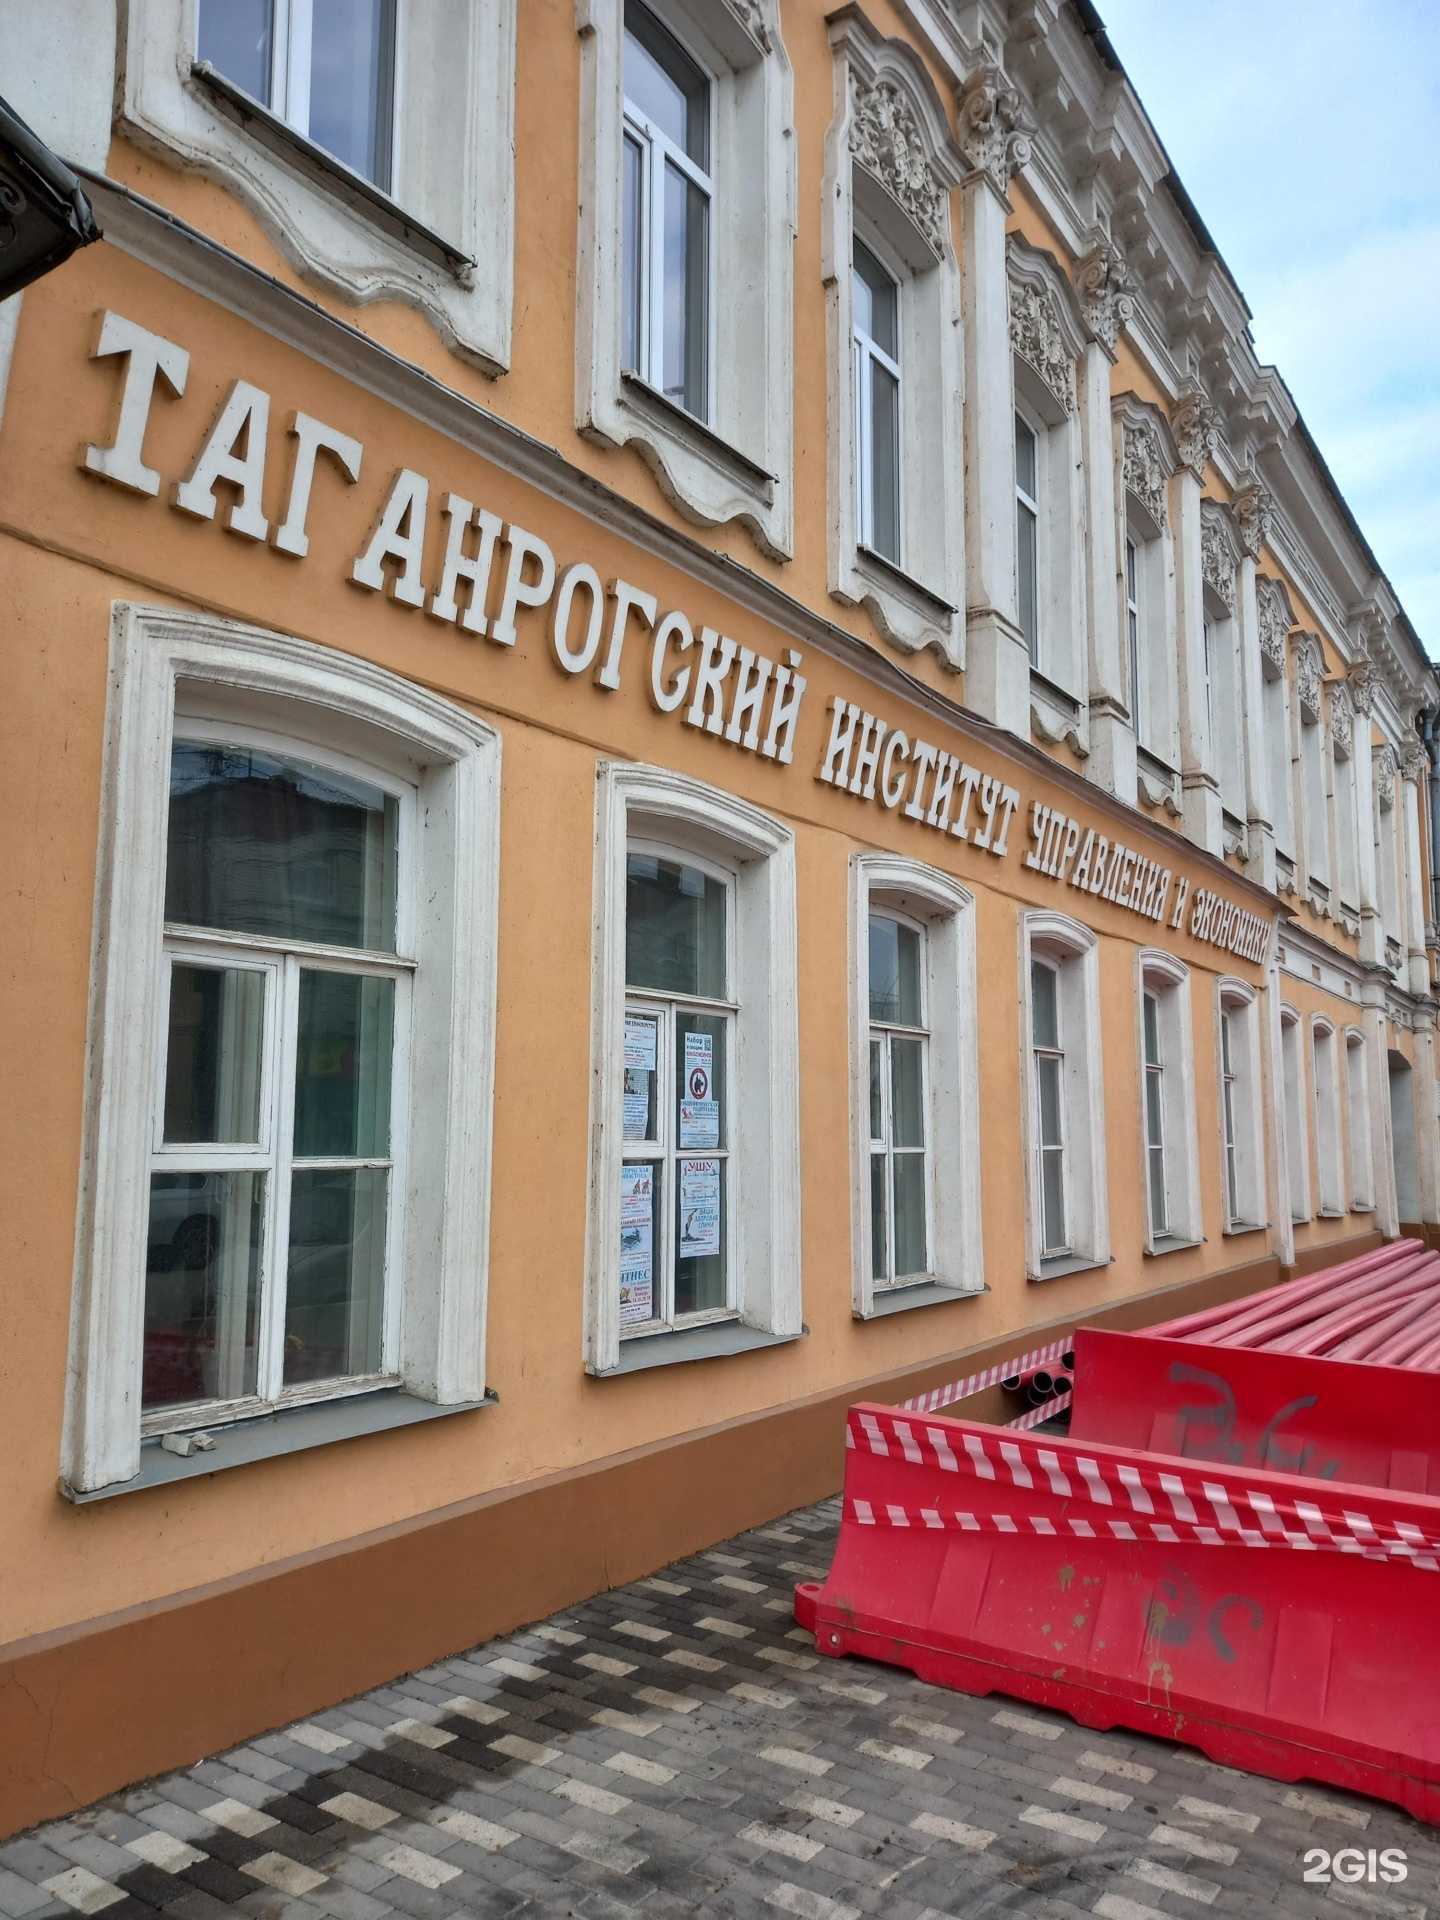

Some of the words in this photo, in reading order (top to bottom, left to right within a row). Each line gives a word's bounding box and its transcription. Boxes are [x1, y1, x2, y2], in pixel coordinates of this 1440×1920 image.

[80, 308, 807, 765] ТАГАНРОГСКИЙ
[816, 695, 1021, 857] ИНСТИТУТ
[1024, 799, 1172, 922] УПРАВЛЕНИЯ
[1171, 876, 1191, 929] И
[1191, 887, 1272, 966] ЭКОНОМИКИ
[687, 1161, 713, 1172] УШУ
